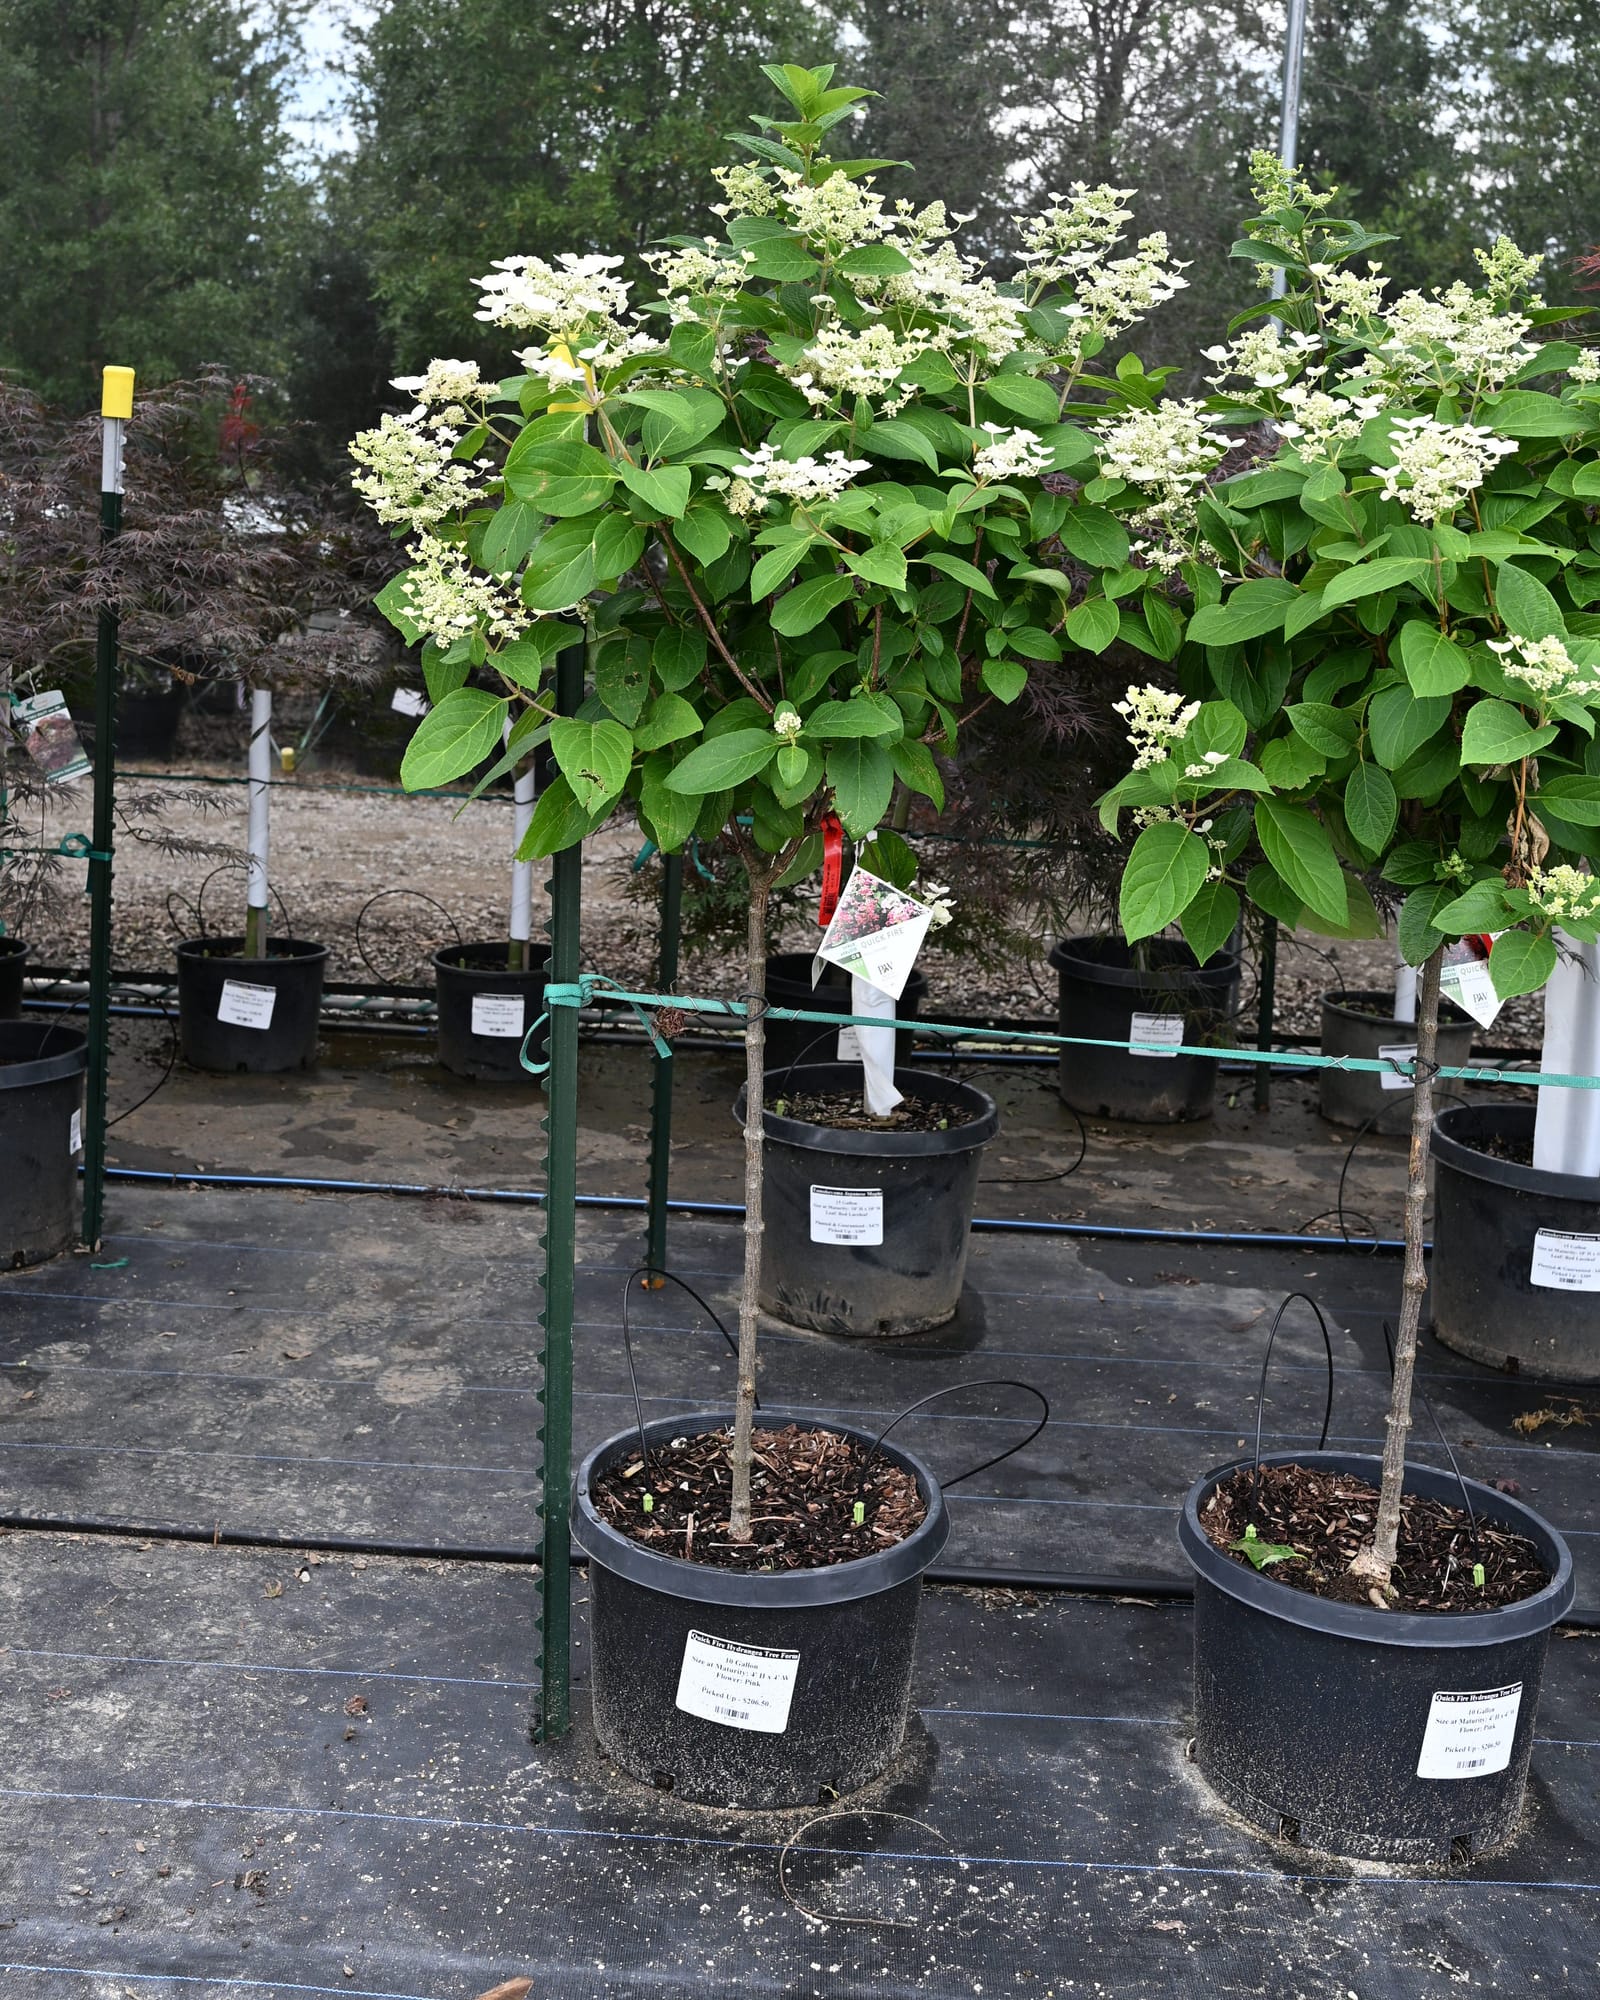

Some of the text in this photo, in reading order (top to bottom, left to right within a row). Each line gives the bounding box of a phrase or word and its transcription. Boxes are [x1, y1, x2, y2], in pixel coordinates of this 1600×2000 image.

[861, 933, 886, 949] QUICK
[691, 1632, 799, 1660] Quick Fire Hydrangea Tree Form
[691, 1655, 704, 1665] Size
[716, 1663, 749, 1677] Maturity:
[726, 1657, 759, 1669] 10 Gallon
[716, 1672, 761, 1687] Flower: Pink
[701, 1686, 725, 1699] Picked
[726, 1694, 737, 1703] Up
[1436, 1694, 1455, 1702] Quick
[1456, 1694, 1469, 1702] Fire
[1470, 1693, 1499, 1702] Hydrangea
[1467, 1745, 1476, 1753] Up
